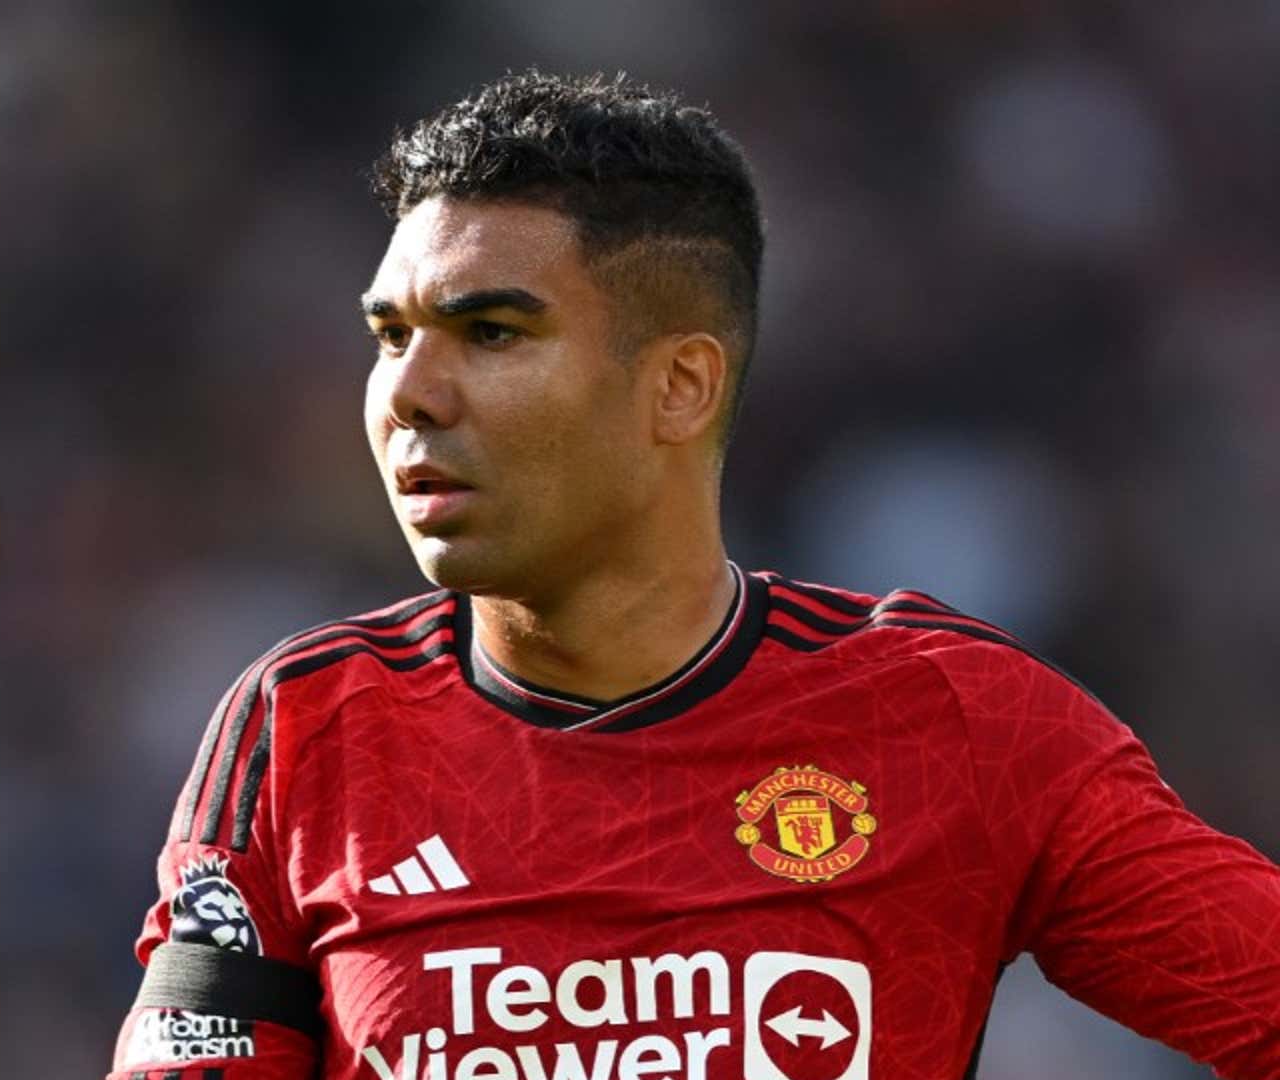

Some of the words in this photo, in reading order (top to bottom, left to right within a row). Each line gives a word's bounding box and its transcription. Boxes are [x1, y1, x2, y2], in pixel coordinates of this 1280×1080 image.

[746, 773, 858, 815] MANCHESTER
[773, 852, 852, 876] UNITED
[422, 947, 731, 1036] Team
